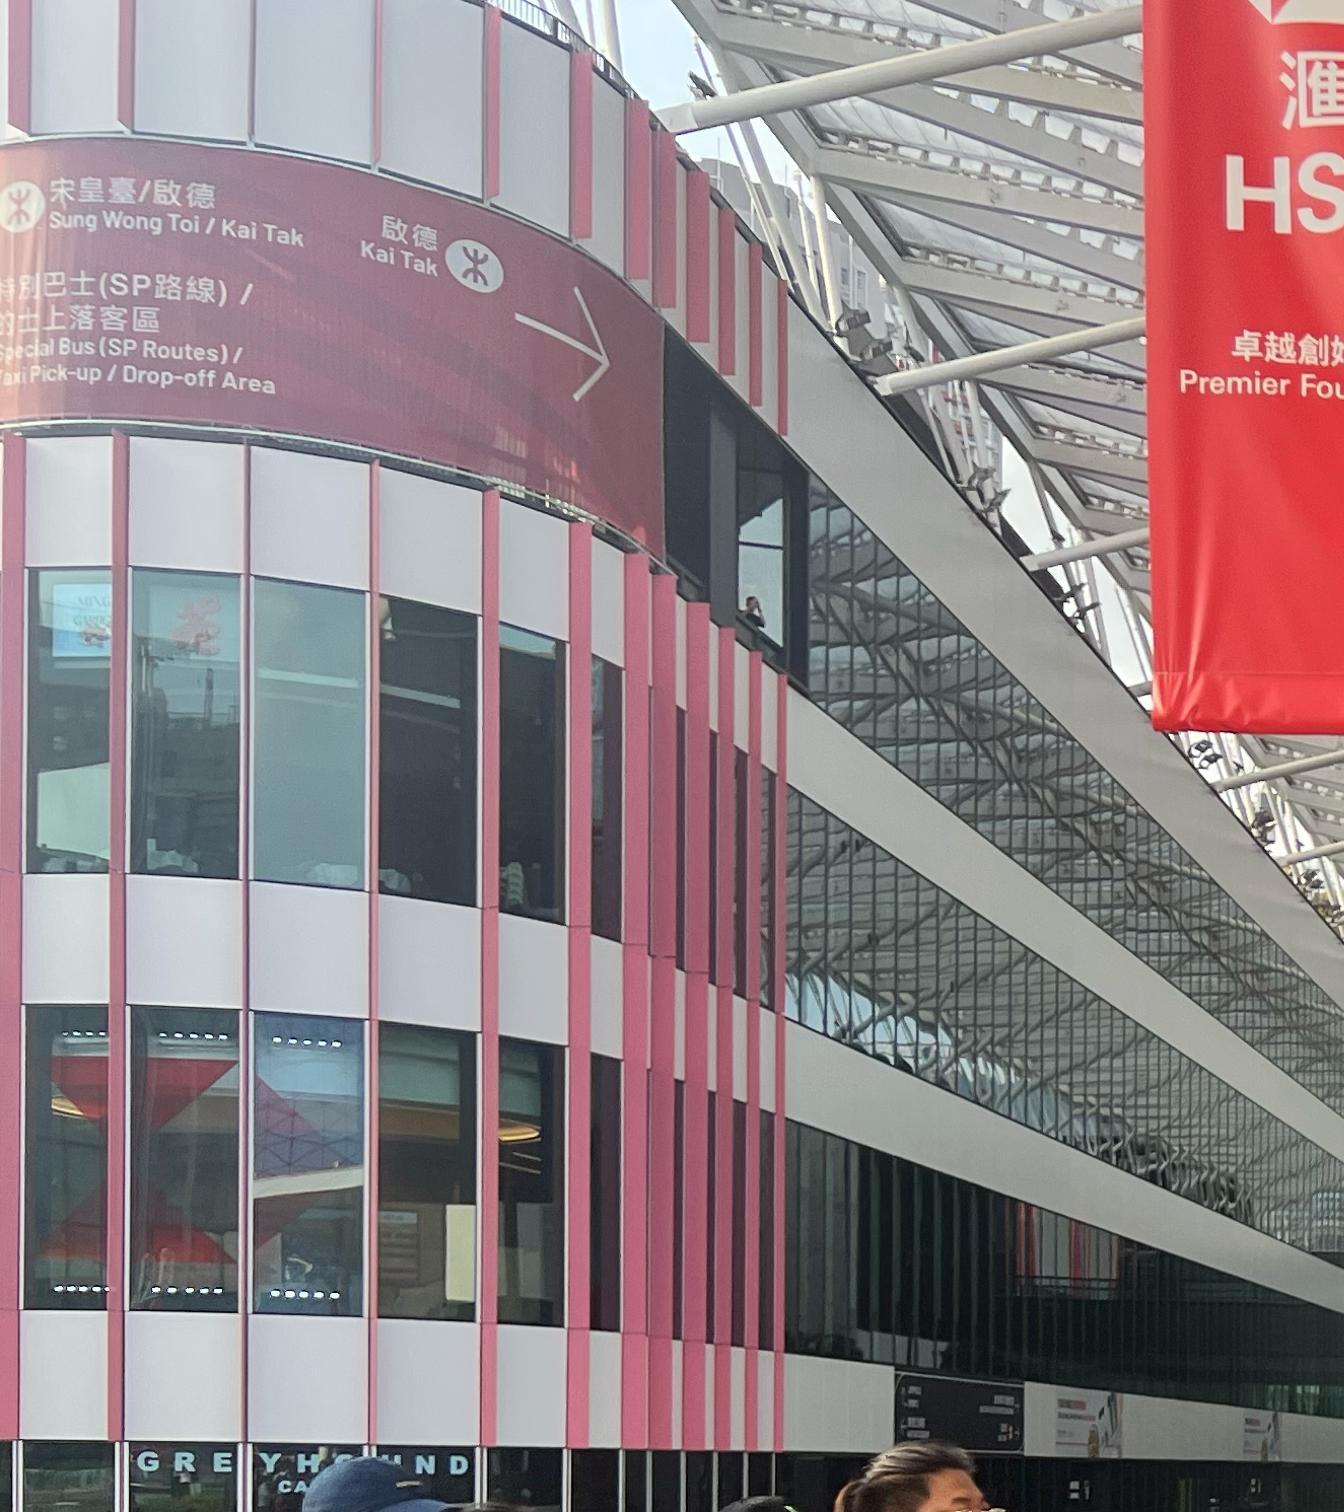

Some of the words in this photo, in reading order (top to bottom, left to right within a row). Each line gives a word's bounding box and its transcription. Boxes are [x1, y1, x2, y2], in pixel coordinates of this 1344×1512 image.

[50, 211, 97, 231] Sung
[102, 210, 162, 235] Wong
[168, 213, 199, 233] Toi
[222, 219, 257, 241] Kai
[264, 223, 305, 248] Tak
[361, 240, 395, 265] Kai
[400, 249, 438, 277] Tak
[59, 337, 96, 356] Bus
[100, 336, 137, 358] (SP
[143, 340, 228, 364] Routes)
[30, 363, 102, 386] Pick-up
[123, 364, 216, 389] Drop-off
[222, 372, 276, 395] Area
[1180, 369, 1291, 396] Premier
[137, 1452, 469, 1475] GREYHND
[278, 1480, 311, 1494] CA
